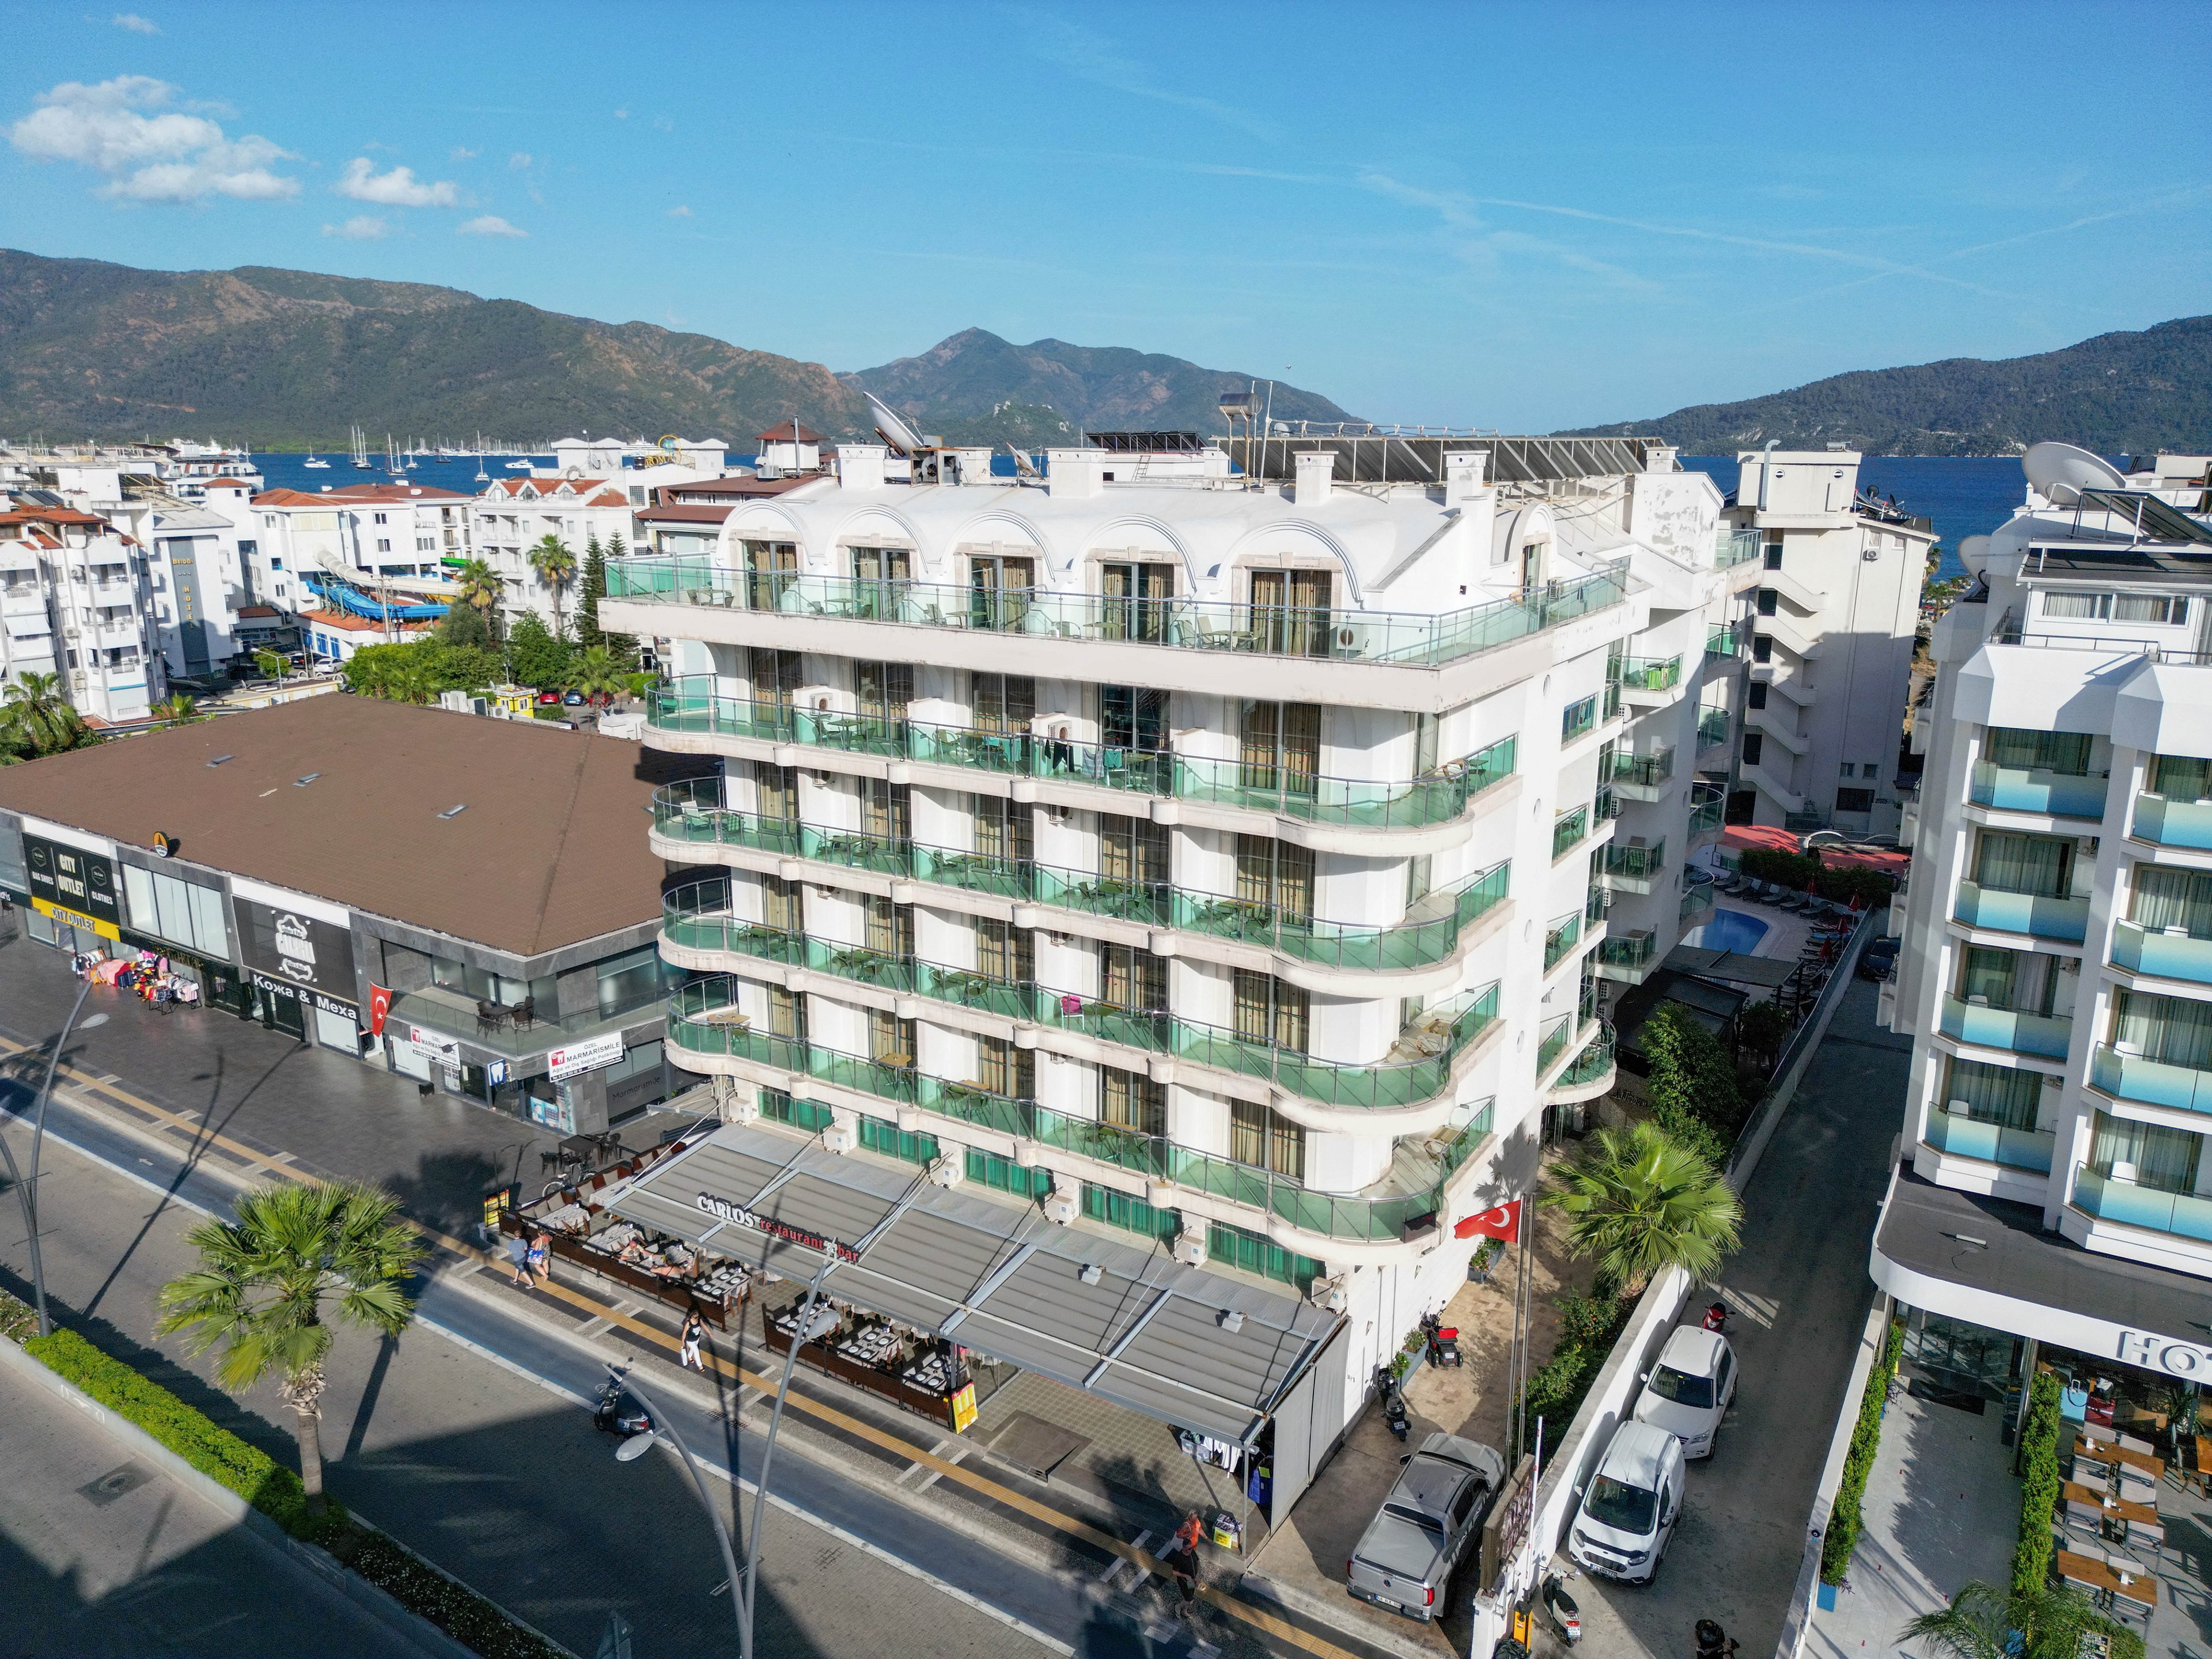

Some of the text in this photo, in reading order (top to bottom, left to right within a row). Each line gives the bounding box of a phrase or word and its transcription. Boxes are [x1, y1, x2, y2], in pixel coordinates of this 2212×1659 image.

[184, 586, 195, 629] HOTEL
[59, 854, 75, 874] CITY
[32, 871, 54, 885] BAG SHOES
[58, 874, 85, 897] OUTLET
[92, 891, 113, 905] CLOTHES
[52, 907, 94, 931] CITY OUTLET
[253, 974, 357, 1020] Кожа & Меха
[567, 1041, 620, 1062] MARMARİSMİLE
[697, 1196, 754, 1228] CARLOS
[759, 1218, 824, 1251] restaurant
[837, 1244, 859, 1263] bar
[2117, 1331, 2212, 1377] HO
